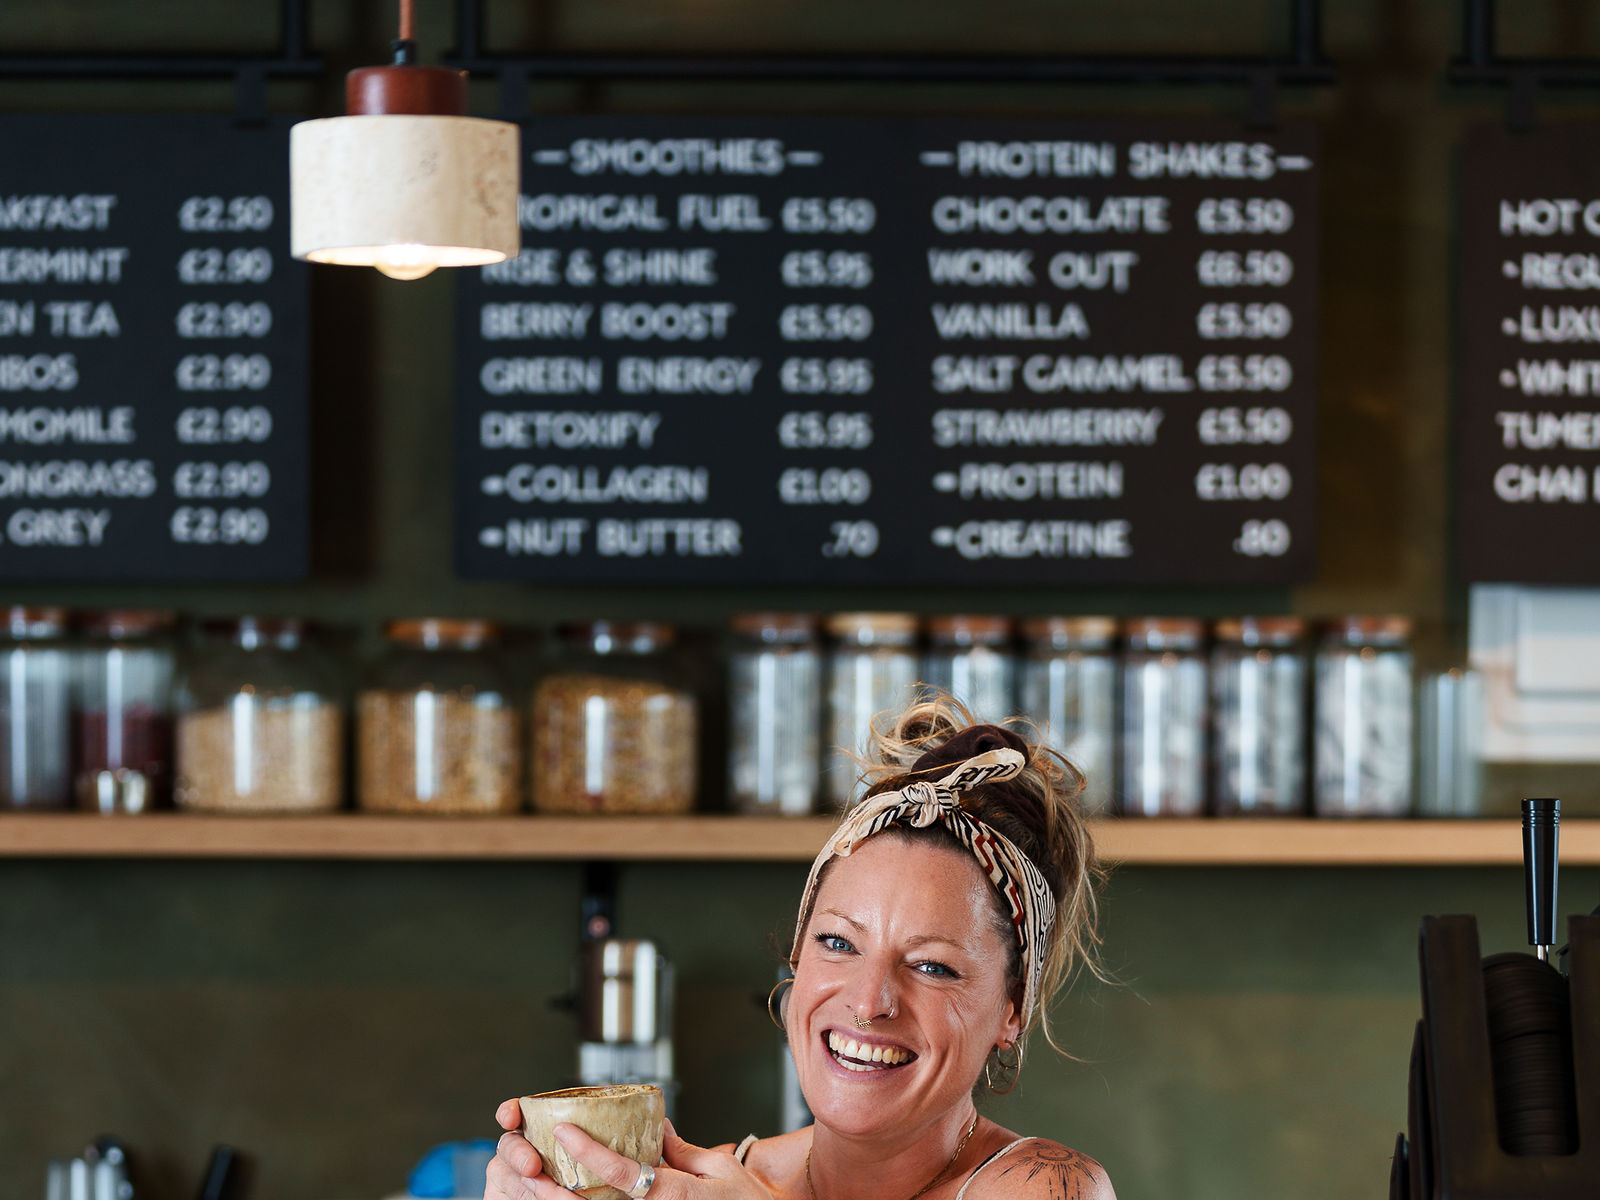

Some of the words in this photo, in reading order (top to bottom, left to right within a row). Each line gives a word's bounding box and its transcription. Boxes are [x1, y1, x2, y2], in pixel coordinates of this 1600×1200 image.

[0, 194, 115, 230] KFAST
[517, 193, 666, 231] ROPICAL
[678, 194, 769, 231] FUEL
[782, 198, 875, 233] £5.50
[933, 196, 1169, 233] CHOCOLATE
[1197, 198, 1292, 233] £5.50
[1500, 199, 1581, 235] HOT
[566, 249, 595, 285] &
[604, 249, 714, 285] SHINE
[782, 251, 872, 287] £5.95
[928, 249, 1033, 285] WORK
[1049, 251, 1138, 291] OUT
[44, 302, 119, 337] TEA
[481, 303, 591, 339] BERRY
[601, 303, 733, 340] BOOST
[780, 304, 872, 340] £5.50
[932, 304, 1088, 339] VANILLA
[1197, 303, 1291, 339] £5.50
[480, 357, 602, 394] GREEN
[618, 357, 759, 393] ENERGY
[781, 358, 873, 393] £5.95
[932, 356, 1018, 392] SALT
[1023, 355, 1193, 392] CARAMEL
[1197, 355, 1291, 391] £5.50
[480, 412, 659, 448] DETOXIFY
[779, 412, 872, 448] £5.95
[933, 409, 1162, 446] STRAWBERRY
[1198, 408, 1291, 444] £5.50
[1497, 412, 1600, 449] TUME
[779, 468, 871, 504] £1.00
[1196, 464, 1291, 500] £1.00
[1494, 464, 1586, 502] CHAI
[7, 509, 109, 545] GREY
[597, 519, 740, 556] BUTTER
